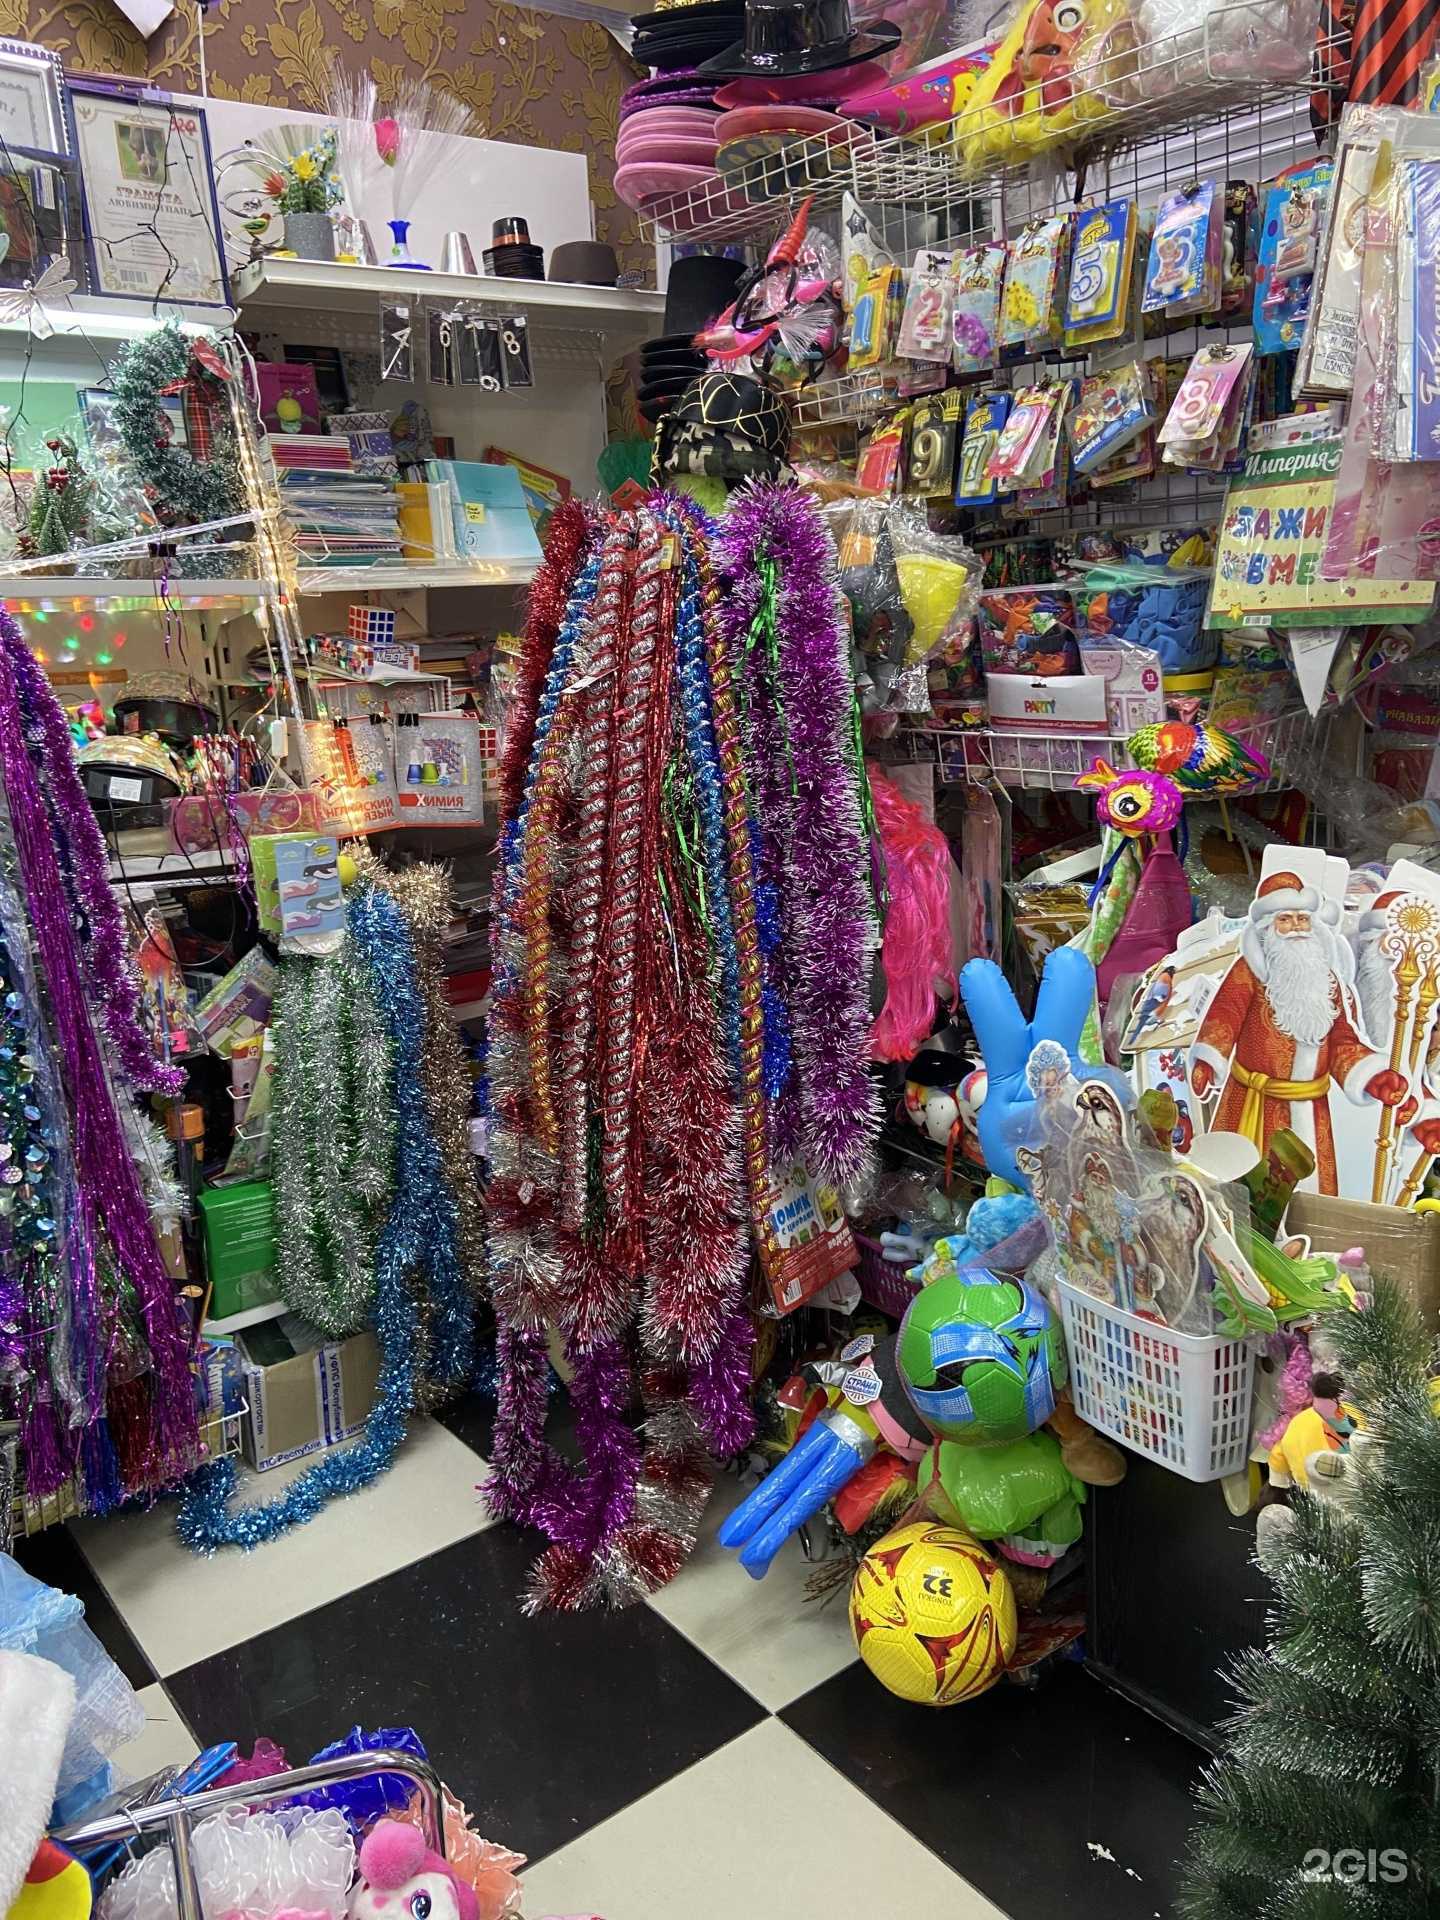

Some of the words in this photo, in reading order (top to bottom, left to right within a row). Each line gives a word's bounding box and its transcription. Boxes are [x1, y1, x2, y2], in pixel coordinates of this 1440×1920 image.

[116, 185, 184, 205] ГРАМОТА
[1070, 246, 1103, 304] 5
[914, 287, 944, 342] 2
[1177, 378, 1212, 420] 8
[911, 427, 942, 481] 9
[961, 433, 991, 483] 7
[1244, 452, 1334, 477] Империя
[1024, 698, 1056, 714] PARTY
[417, 794, 464, 808] ХИМИЯ
[365, 807, 394, 821] ЯЗЫК
[329, 1353, 340, 1381] УФПС
[847, 1377, 878, 1391] СТРАНА
[922, 1574, 953, 1598] 32
